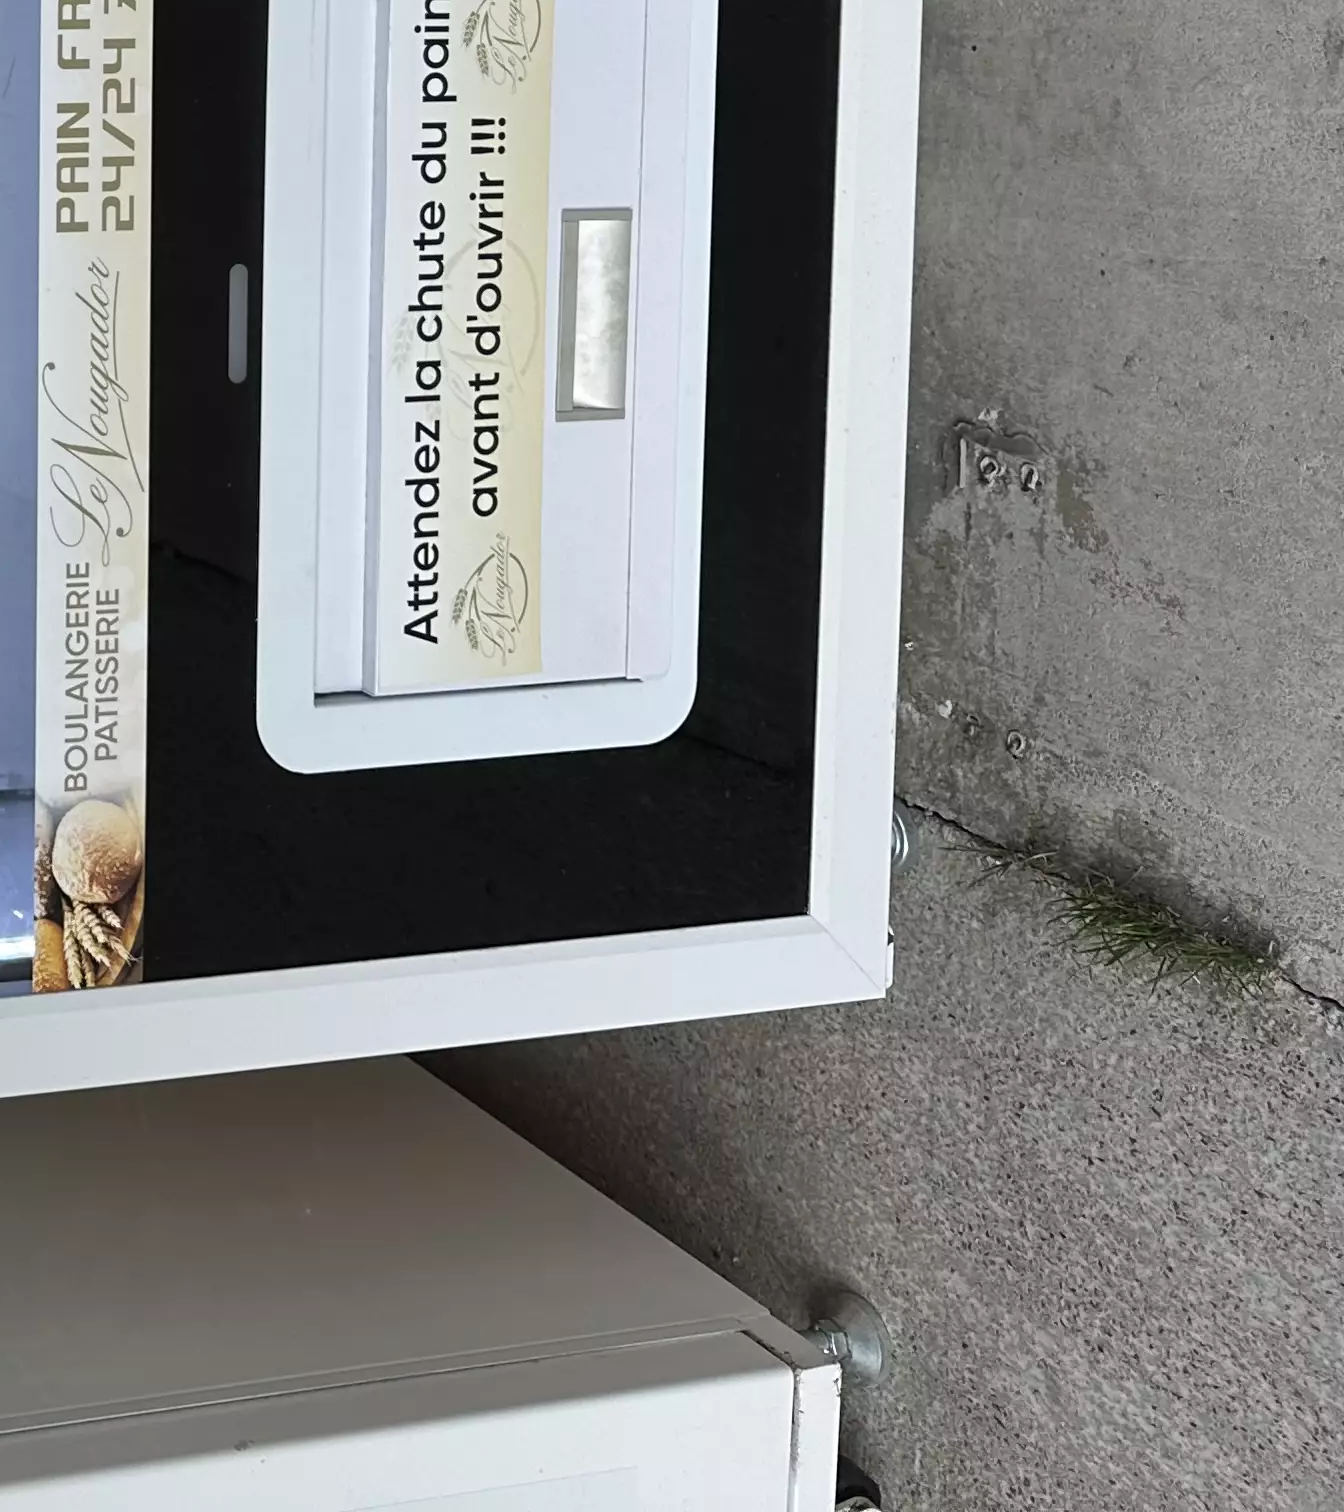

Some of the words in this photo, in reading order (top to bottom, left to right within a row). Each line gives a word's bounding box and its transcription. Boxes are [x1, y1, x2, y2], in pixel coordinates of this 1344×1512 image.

[56, 102, 90, 234] PAIN
[102, 37, 137, 232] 24/24
[412, 121, 447, 183] du
[472, 116, 507, 155] !!!
[408, 201, 446, 342] chute
[466, 171, 506, 356] d'ouvrir
[42, 257, 133, 537] Nougador
[404, 360, 442, 404] la
[467, 372, 500, 517] avant
[50, 464, 110, 567] Le
[403, 419, 441, 645] Attendez
[64, 562, 90, 792] BOULANGERIE
[93, 589, 121, 762] PATISSERIE
